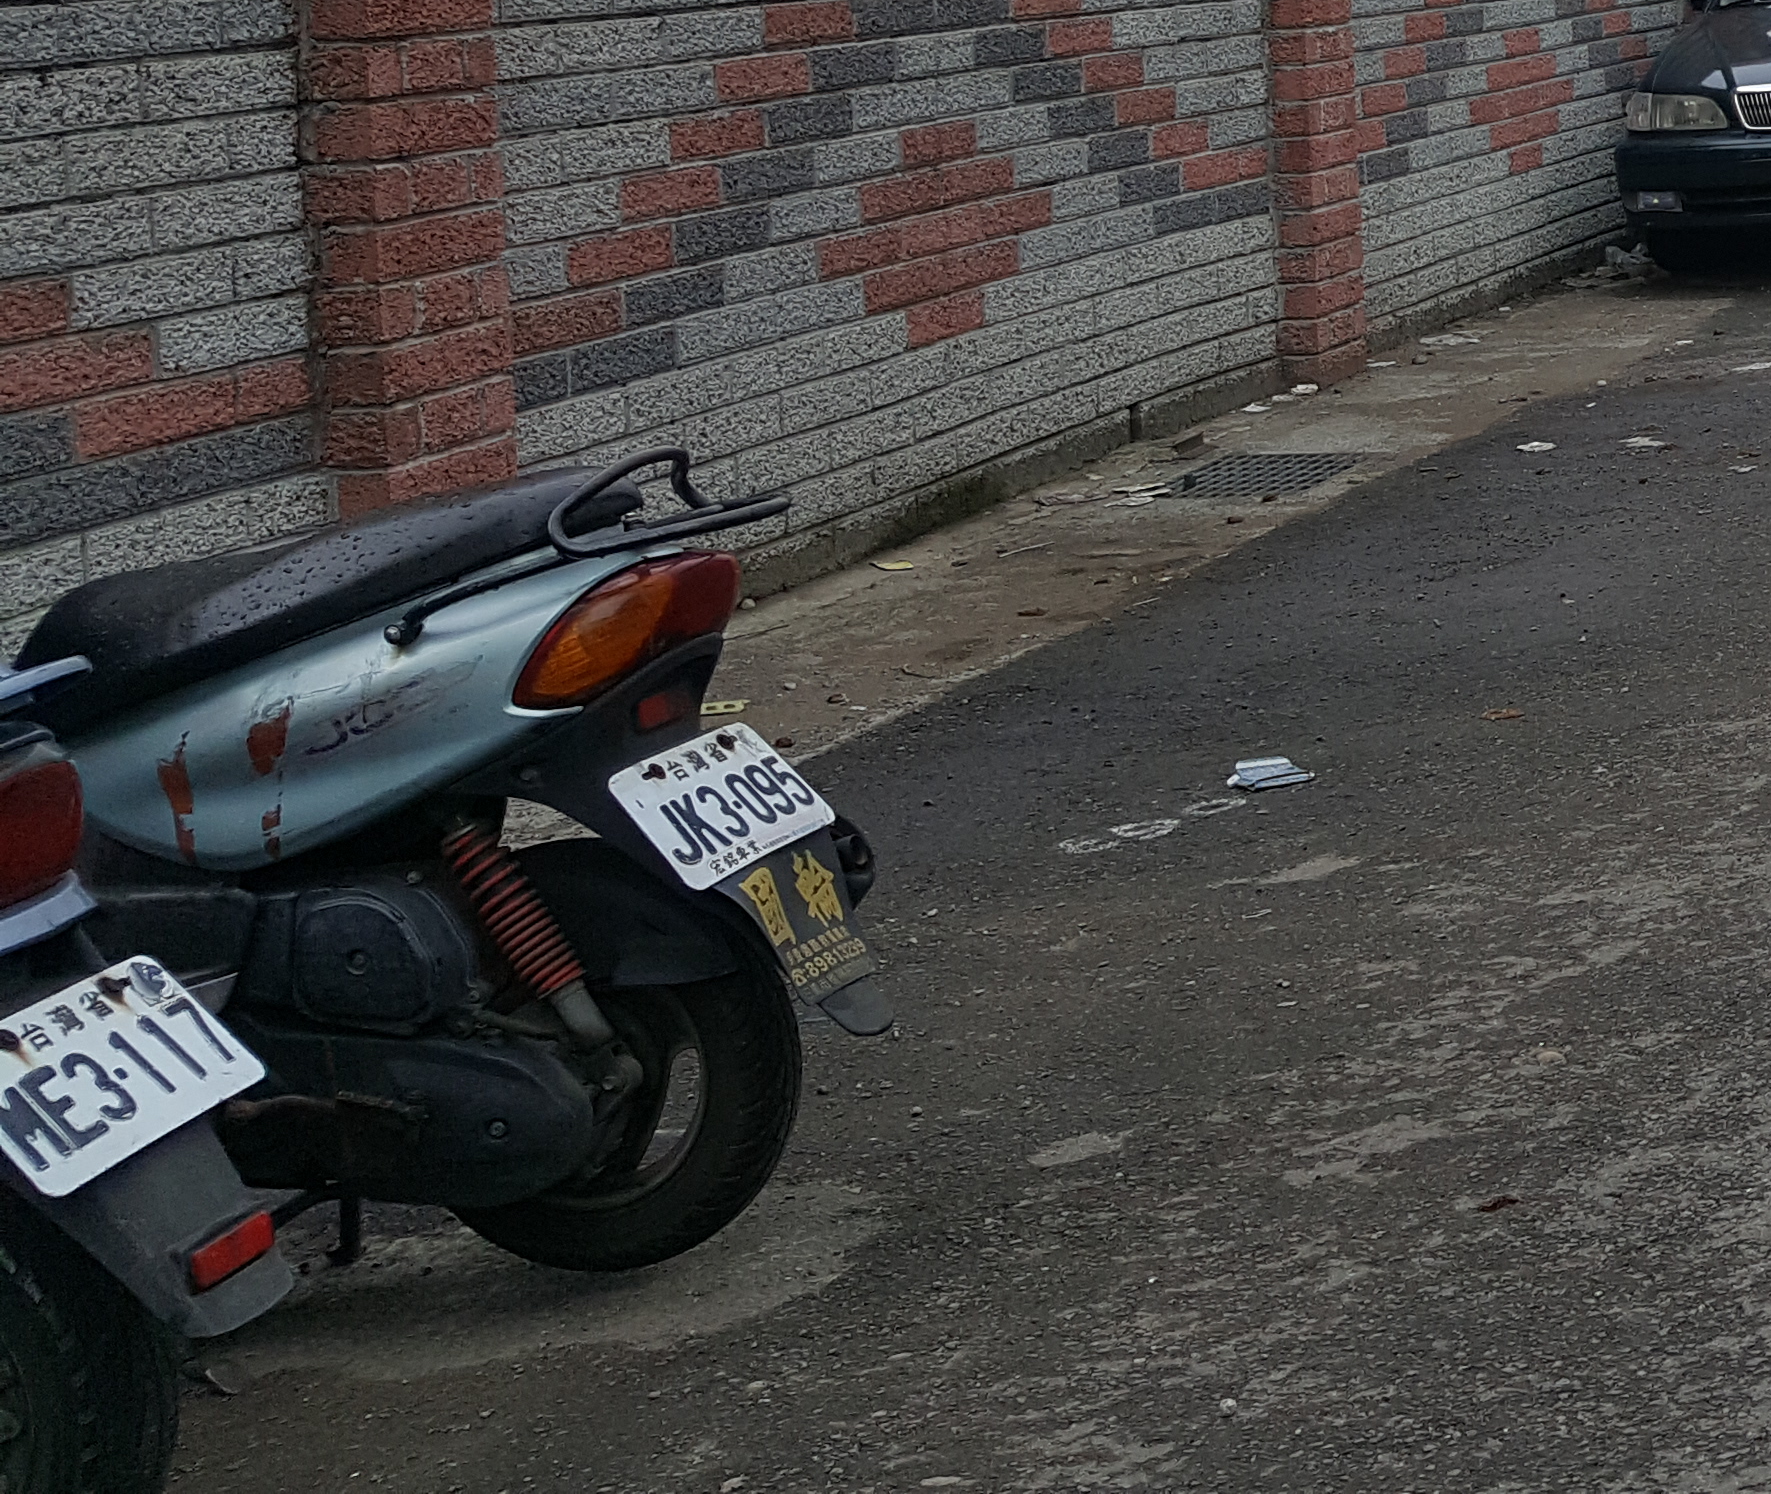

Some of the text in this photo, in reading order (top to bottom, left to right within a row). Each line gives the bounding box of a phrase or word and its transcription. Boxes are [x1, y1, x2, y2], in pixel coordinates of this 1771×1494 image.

[659, 755, 815, 866] JK3-095
[20, 990, 115, 1053] 台灣省
[0, 996, 237, 1172] ME3-117
